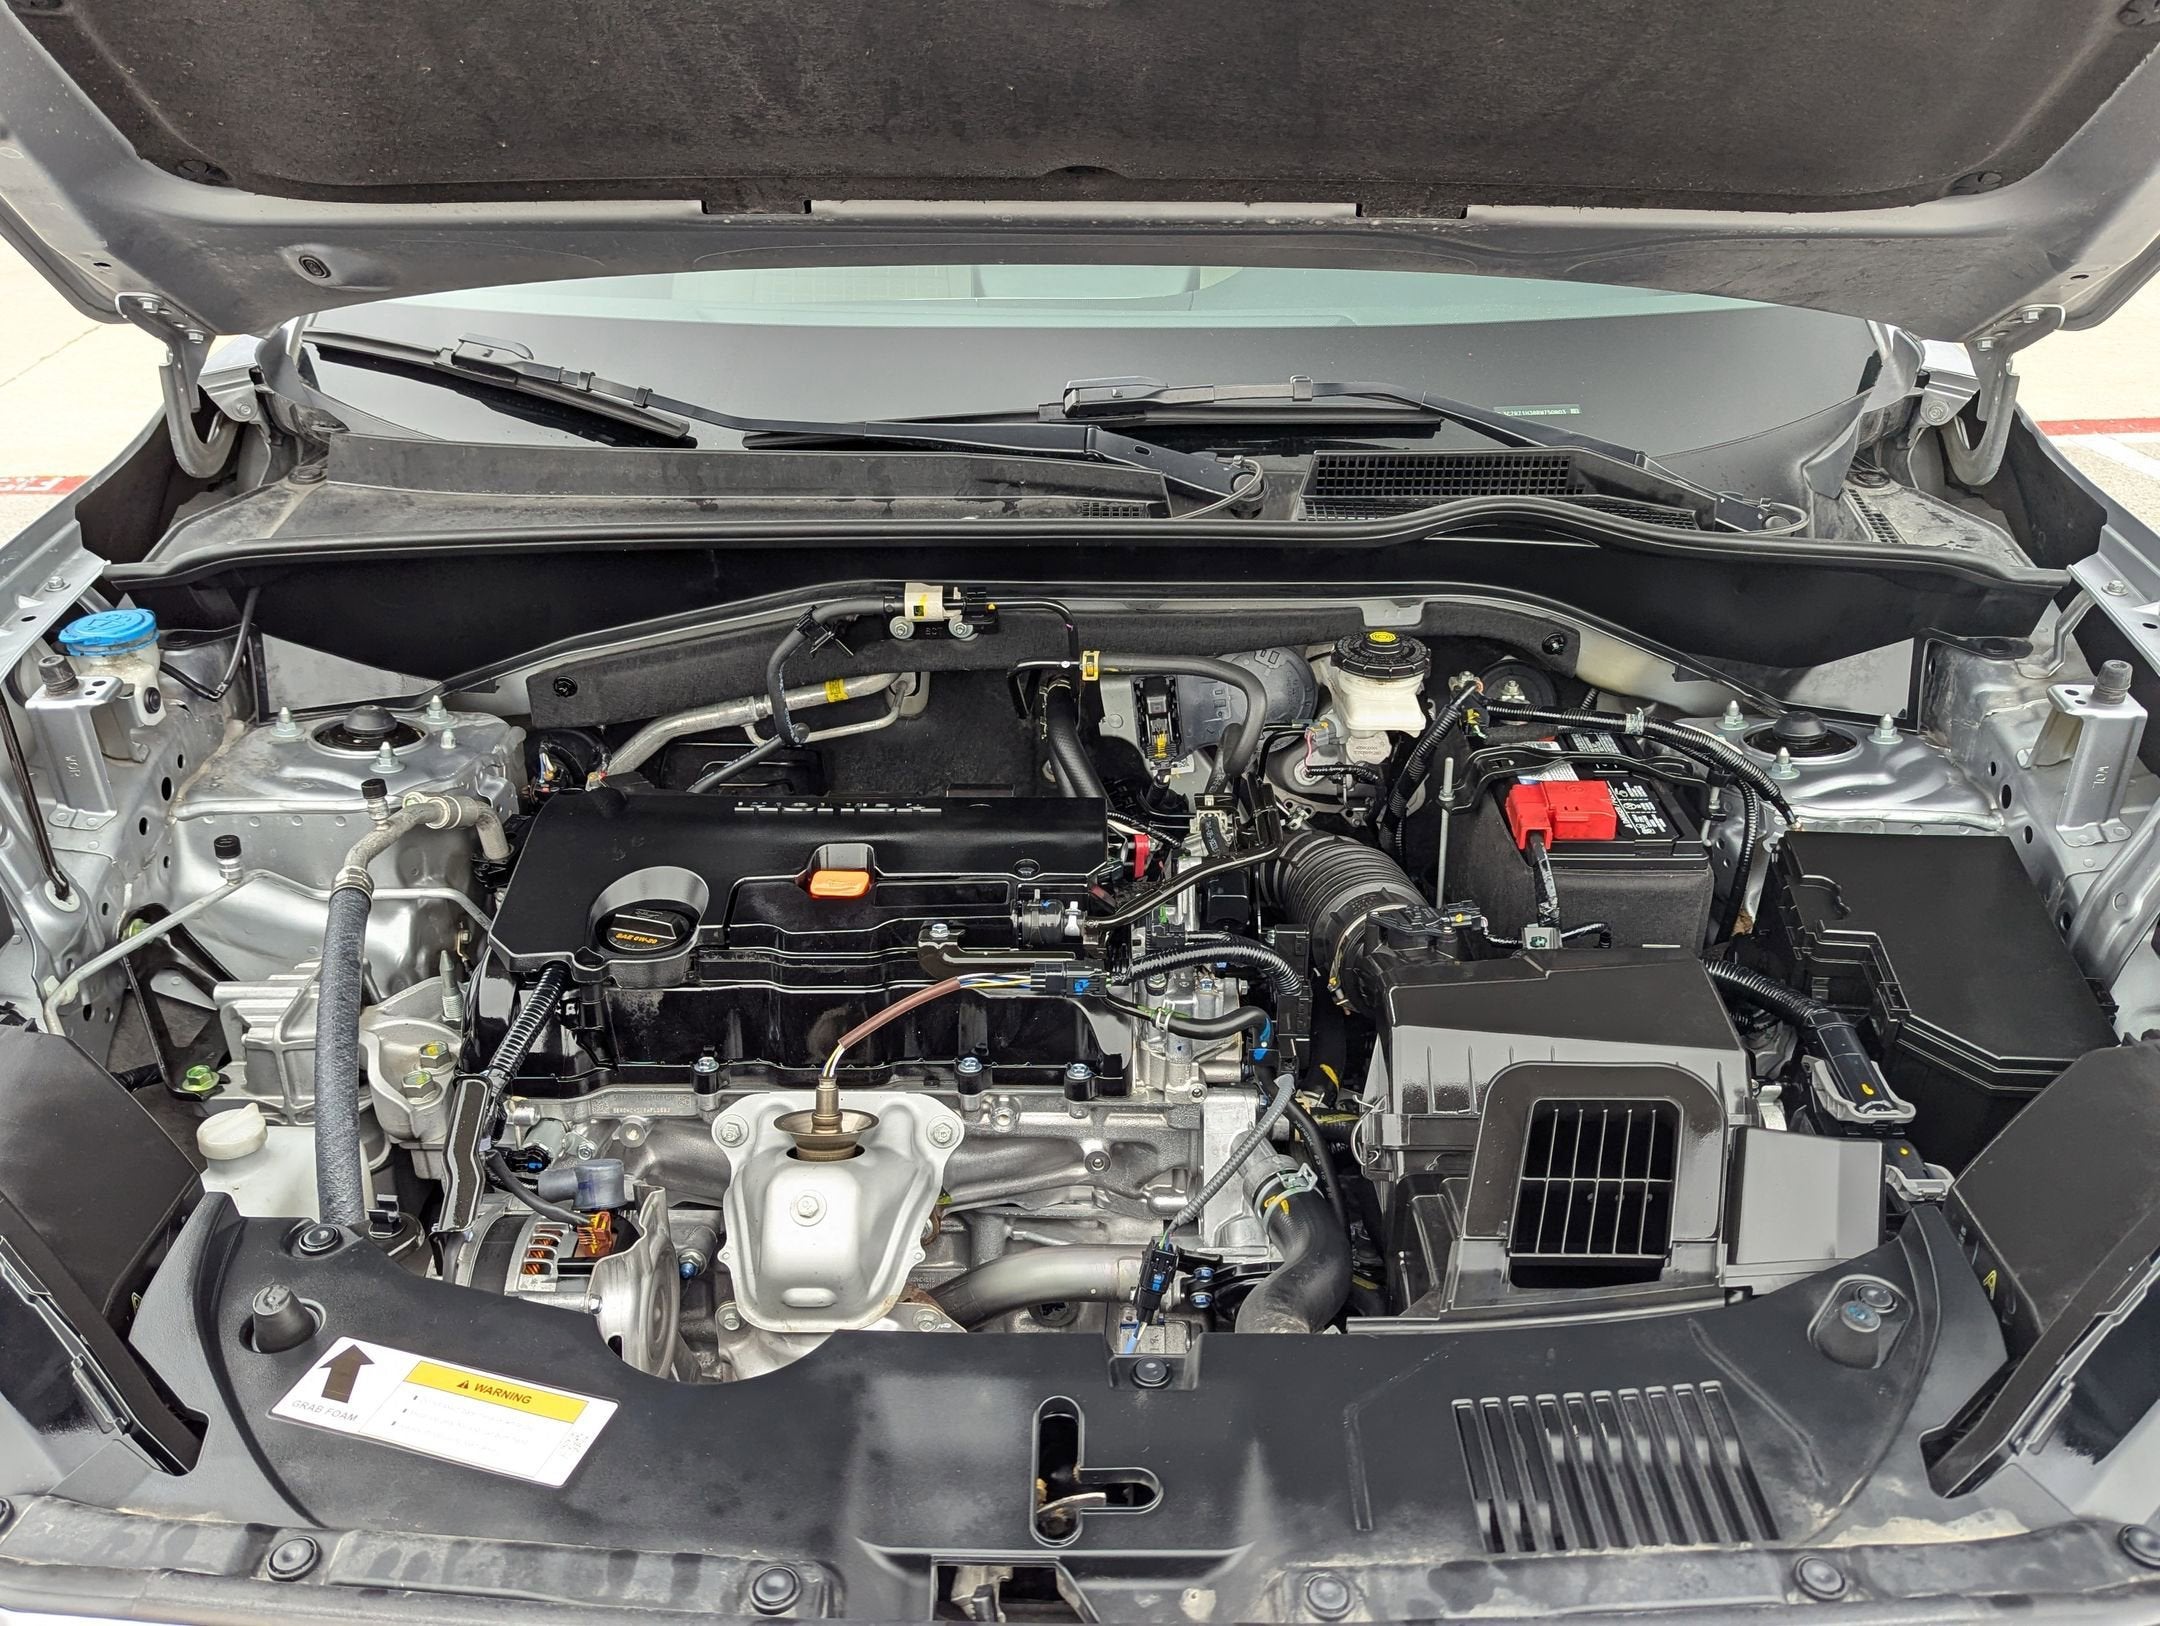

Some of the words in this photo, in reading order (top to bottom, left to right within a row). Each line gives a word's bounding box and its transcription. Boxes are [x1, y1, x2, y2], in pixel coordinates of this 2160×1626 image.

[615, 932, 633, 941] SAE
[633, 935, 658, 945] 0W-20
[473, 1383, 532, 1405] WARNING
[291, 1399, 325, 1414] GRAB
[324, 1408, 359, 1421] FOAM
